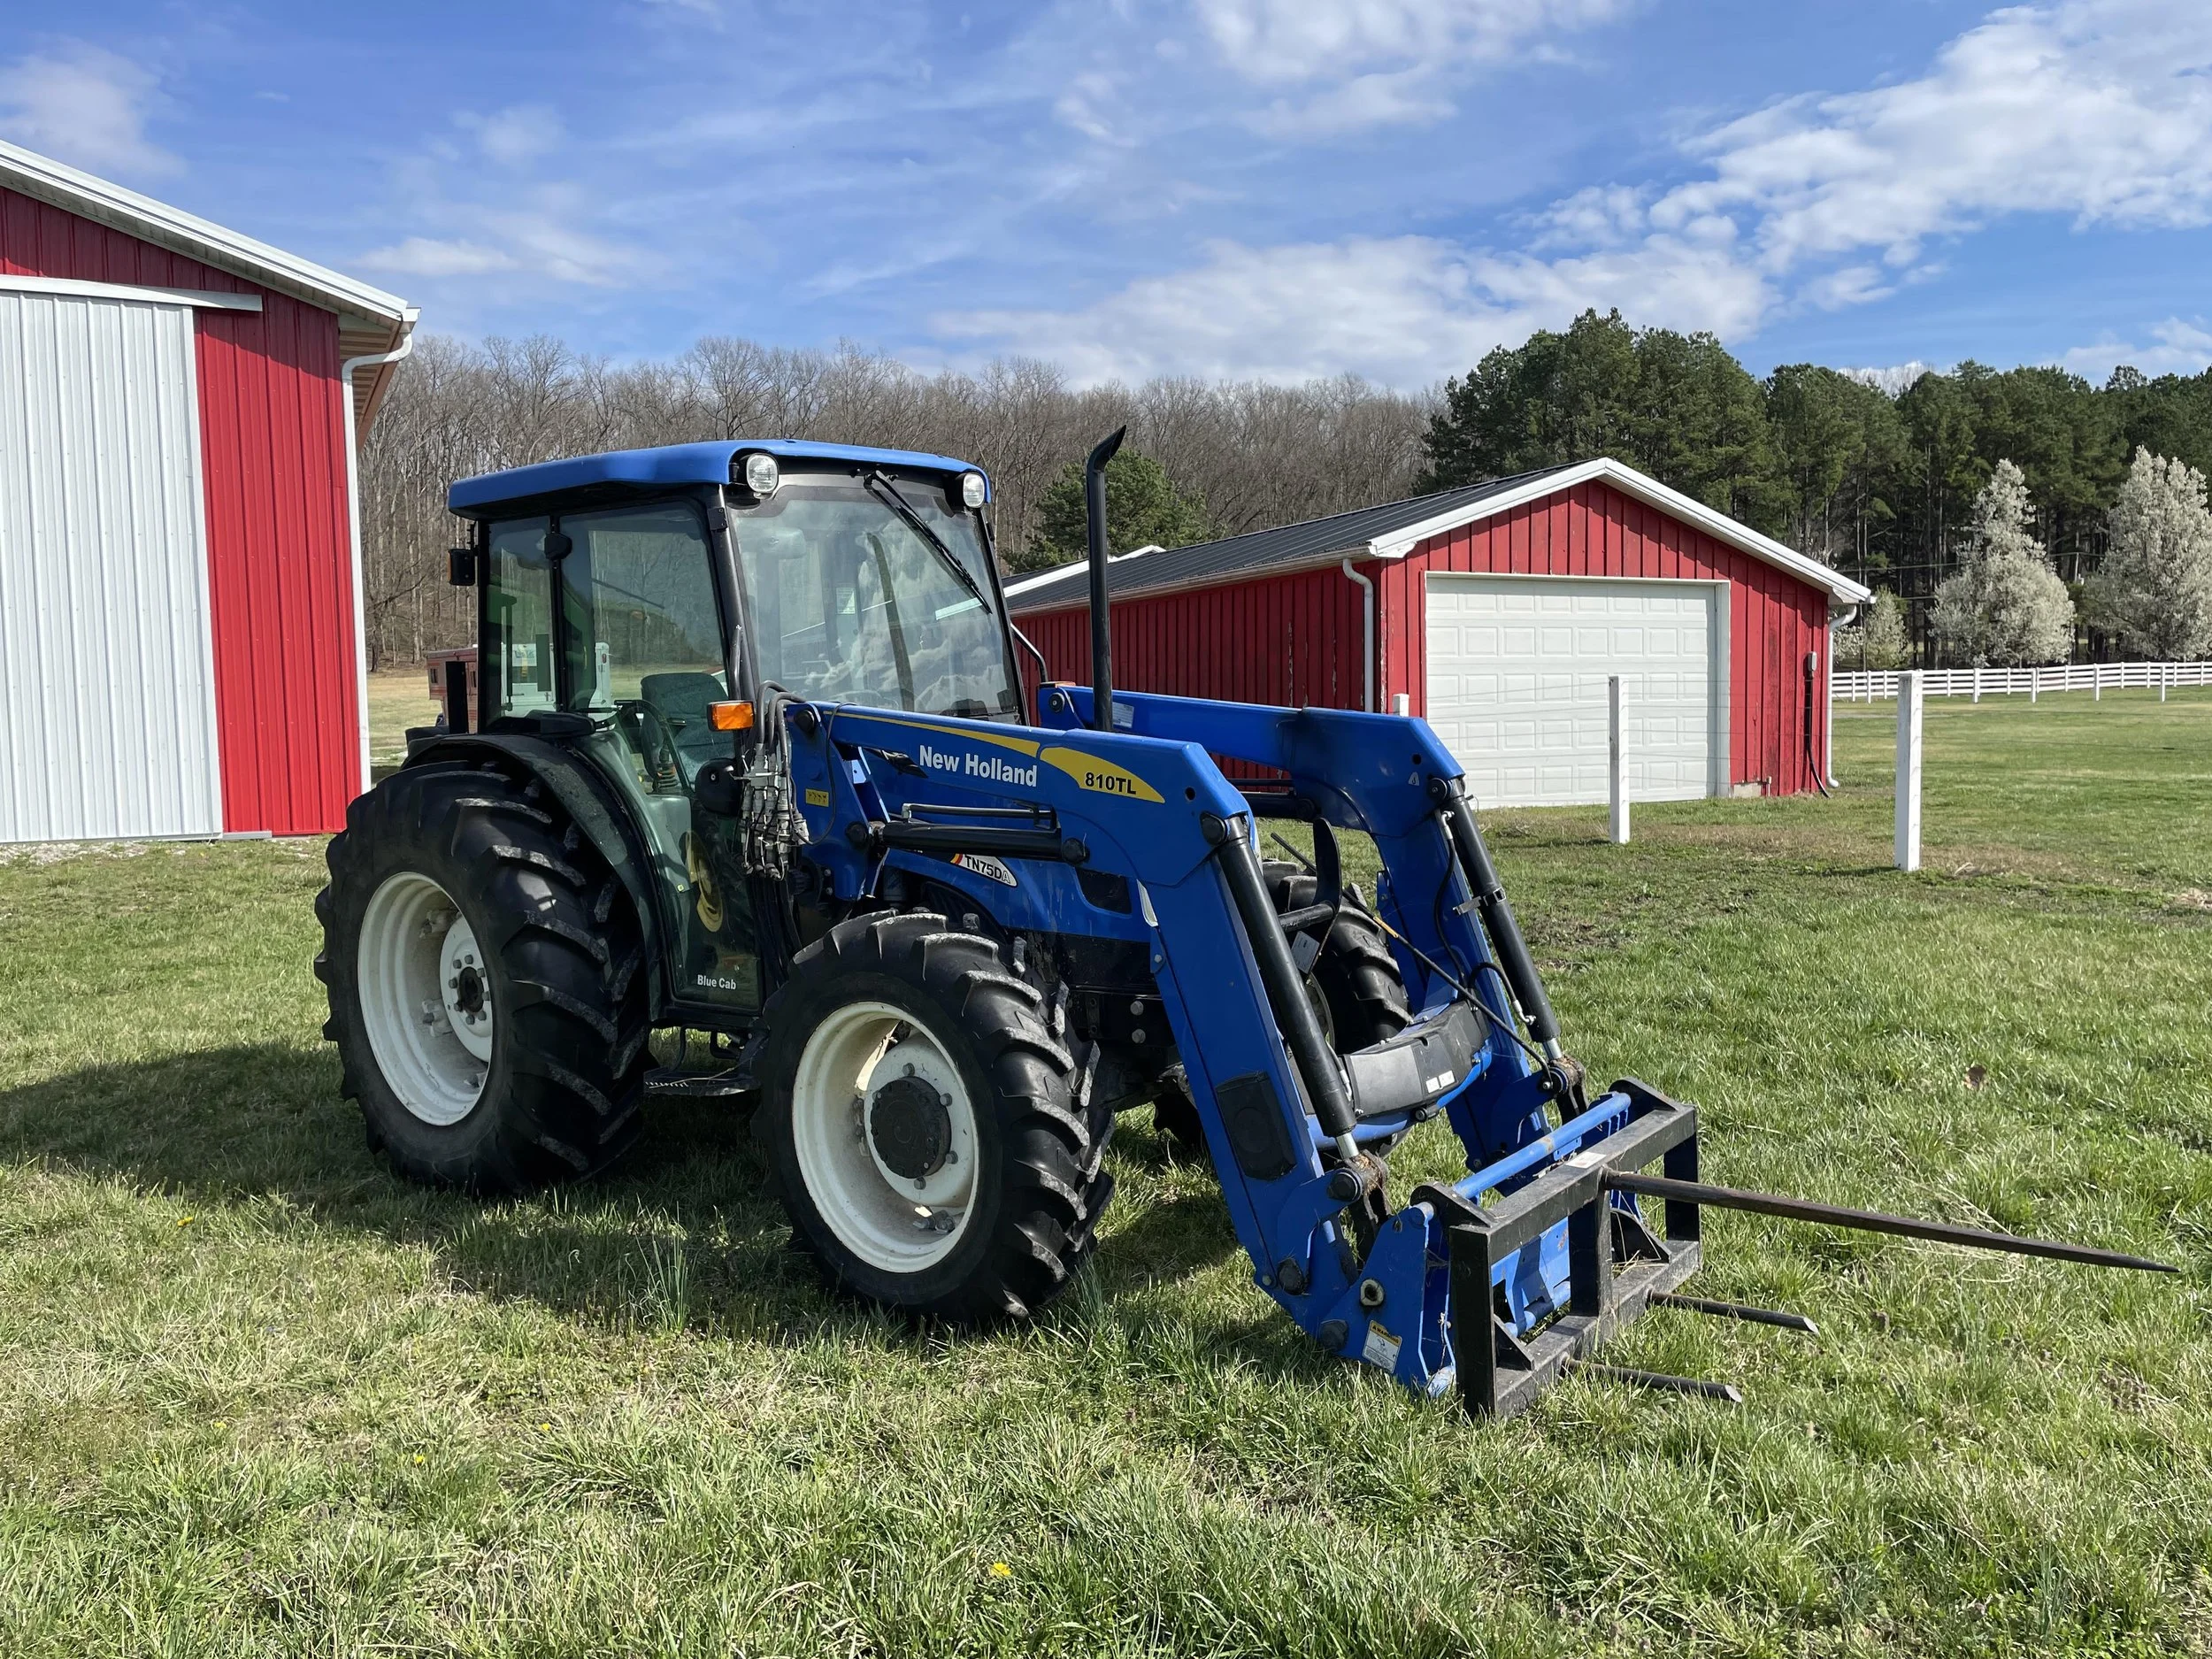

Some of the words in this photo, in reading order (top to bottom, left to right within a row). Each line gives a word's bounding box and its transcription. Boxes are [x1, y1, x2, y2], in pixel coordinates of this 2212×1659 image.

[919, 745, 960, 772] New
[965, 753, 1038, 787] Holland
[1085, 772, 1137, 795] 810TL
[964, 855, 1011, 884] TN75DA
[697, 974, 718, 988] Blue
[718, 977, 737, 990] Cab
